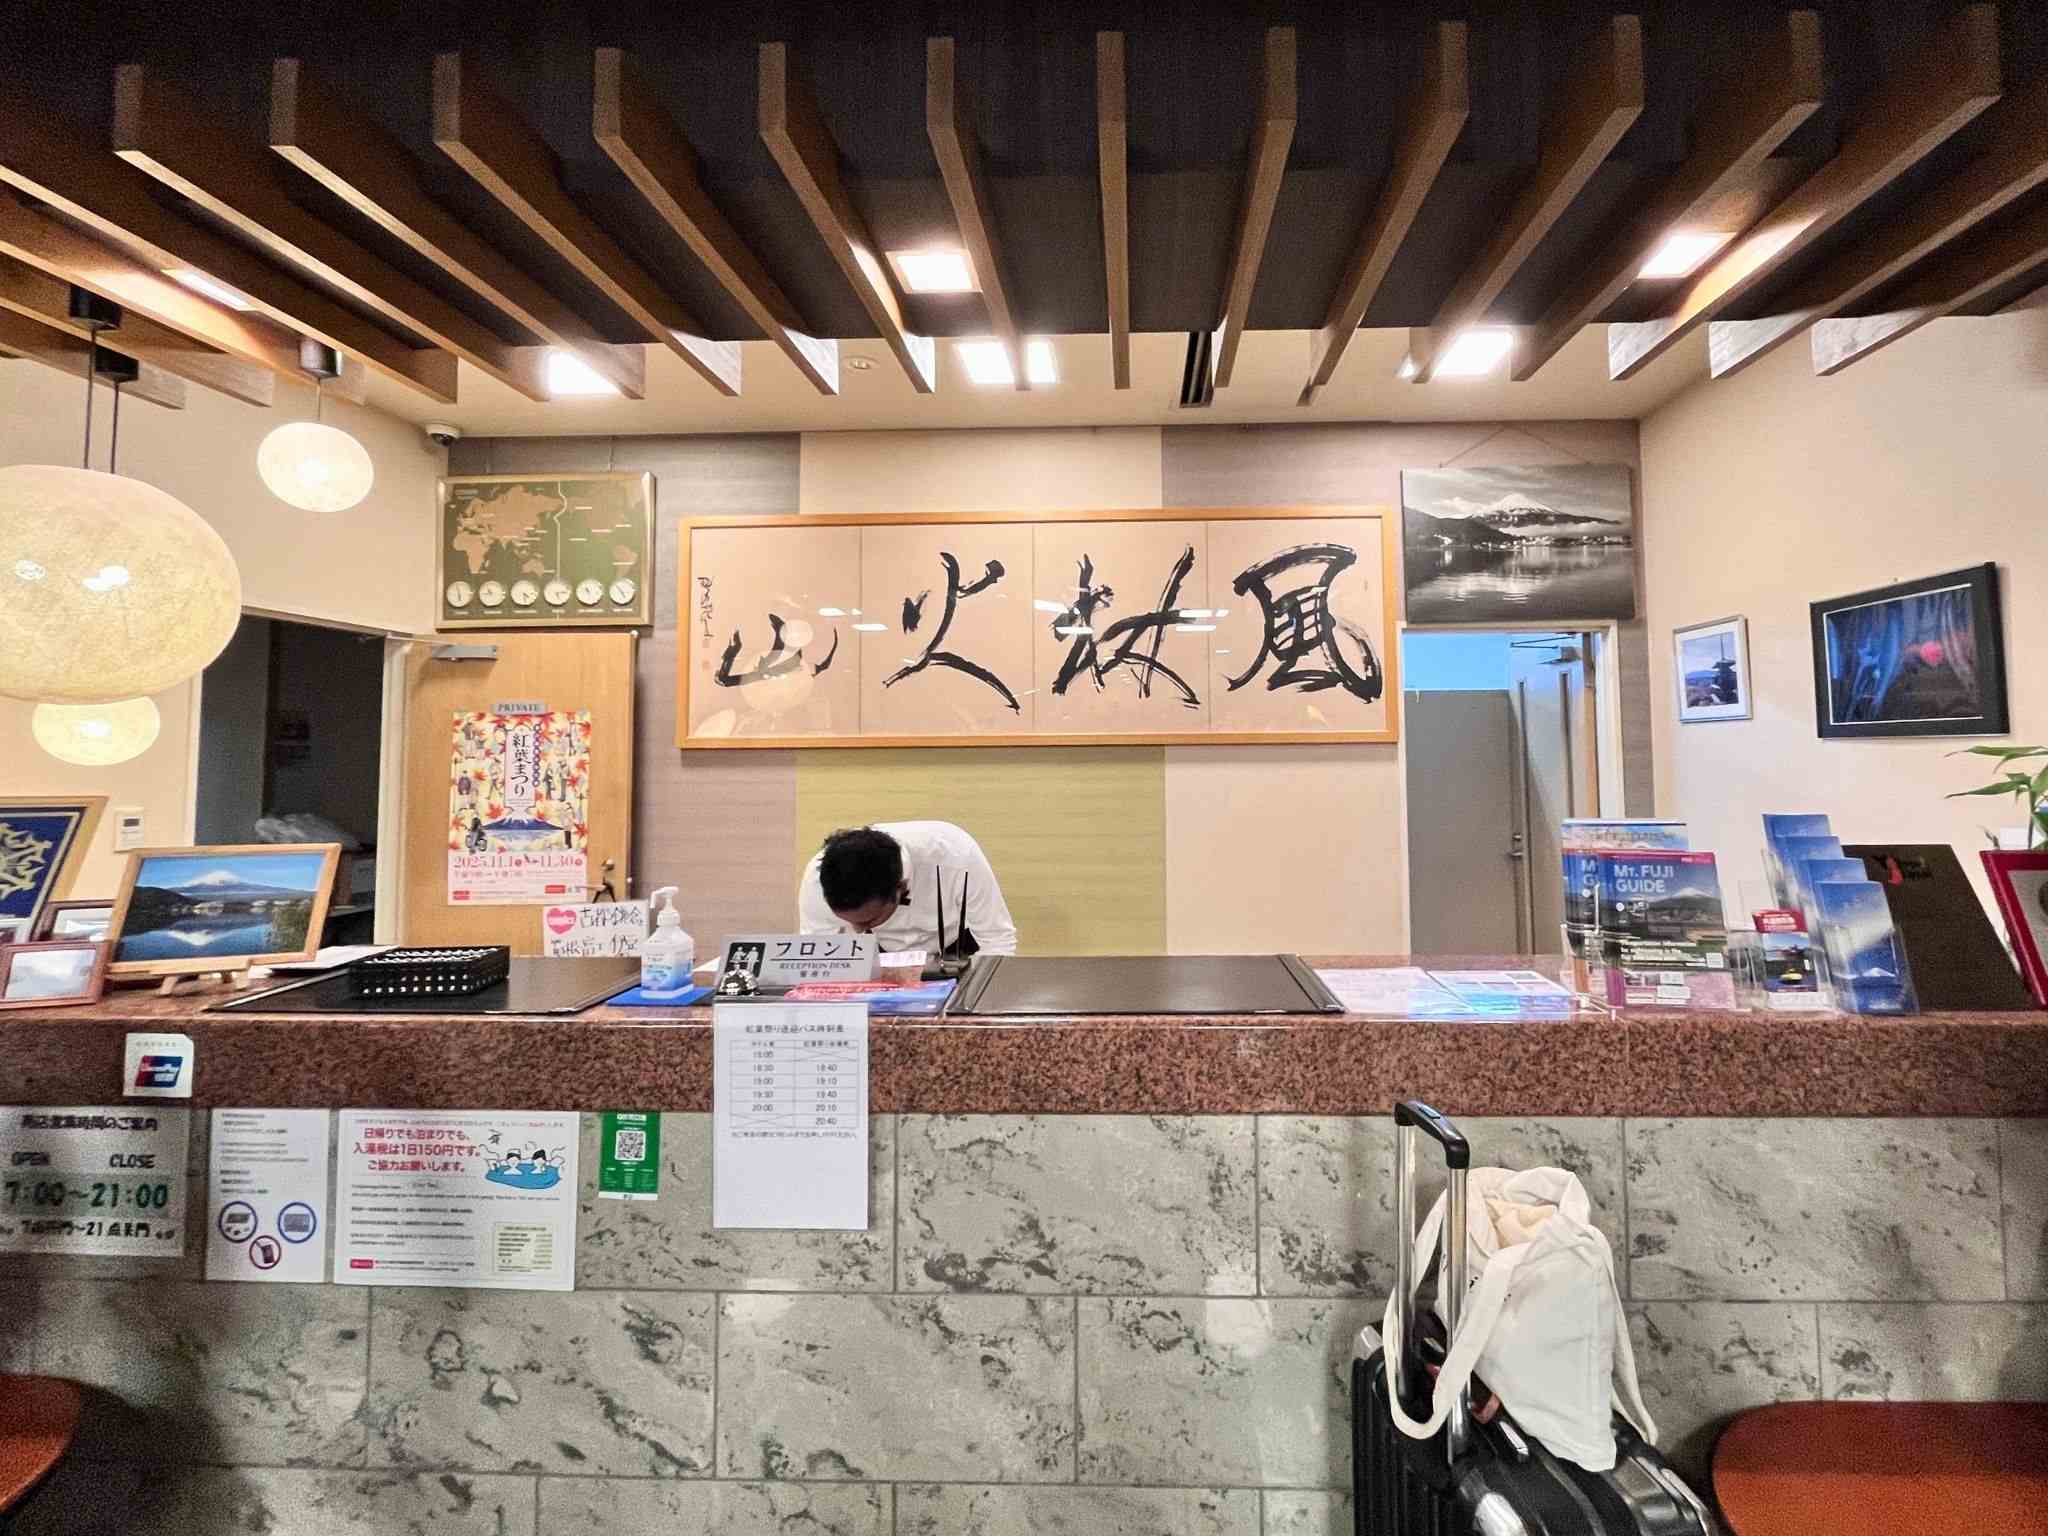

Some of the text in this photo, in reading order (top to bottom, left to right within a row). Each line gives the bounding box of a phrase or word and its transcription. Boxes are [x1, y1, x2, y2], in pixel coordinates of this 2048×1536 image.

[498, 704, 540, 712] PRIVATE
[512, 734, 531, 797] 紅葉まつり
[1643, 865, 1674, 879] FUJI
[1616, 879, 1665, 893] GUIDE
[776, 940, 863, 957] フロント
[364, 1127, 471, 1140] 日帰りでも泊まりでも、
[12, 1152, 156, 1168] OPEN CLOSE
[367, 1160, 465, 1172] ご協力お願いします。
